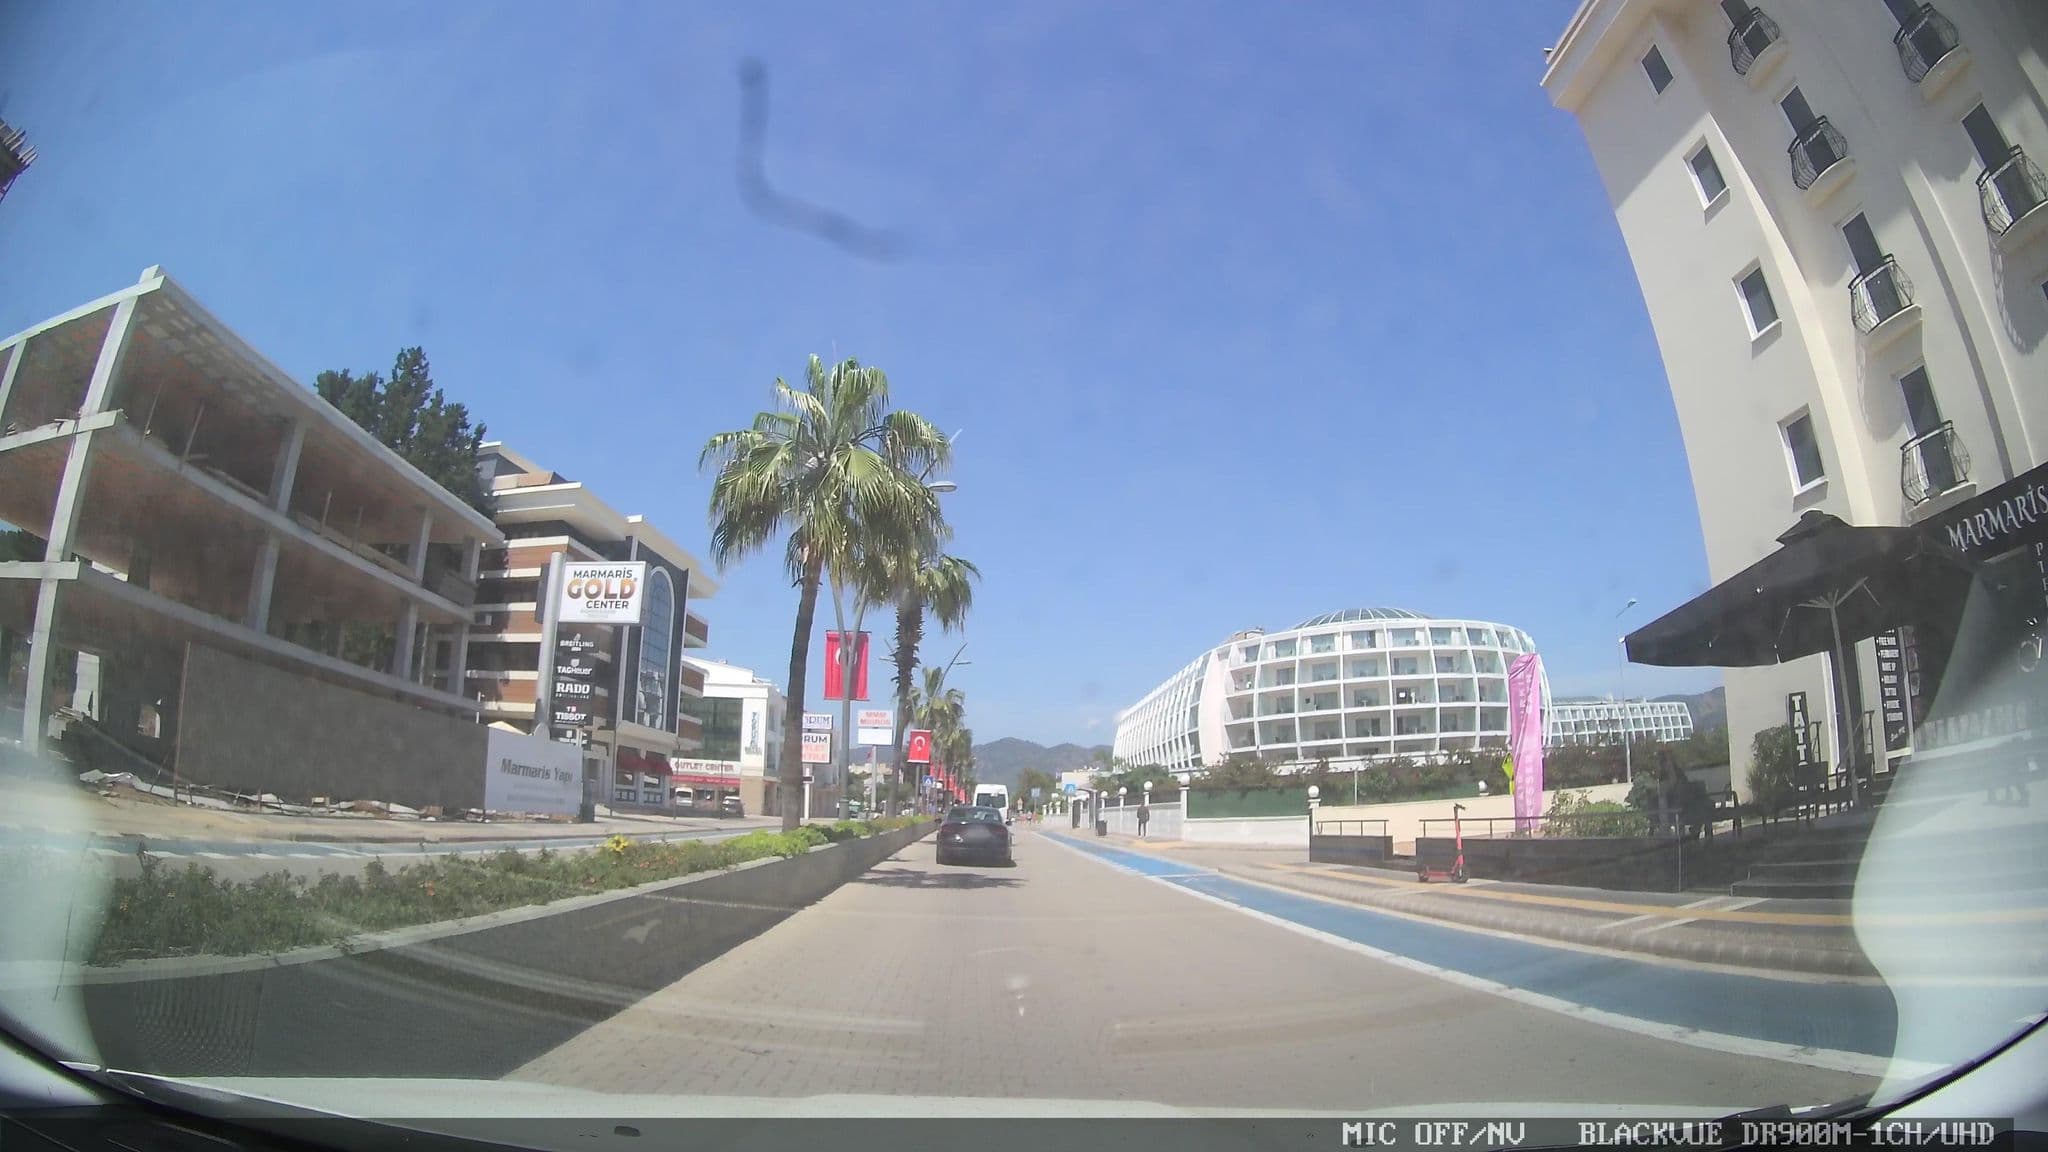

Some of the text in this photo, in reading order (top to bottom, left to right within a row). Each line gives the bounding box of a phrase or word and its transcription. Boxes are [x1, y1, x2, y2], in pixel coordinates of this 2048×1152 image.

[1945, 484, 2048, 551] MARMARİS
[573, 567, 633, 578] MARMARİS
[567, 578, 635, 599] GOLD
[586, 600, 629, 609] CENTER
[556, 682, 590, 694] RADO
[555, 711, 587, 721] TISSOT
[1791, 695, 1808, 766] TATT
[803, 735, 827, 743] RUM
[500, 758, 551, 780] Marmaris
